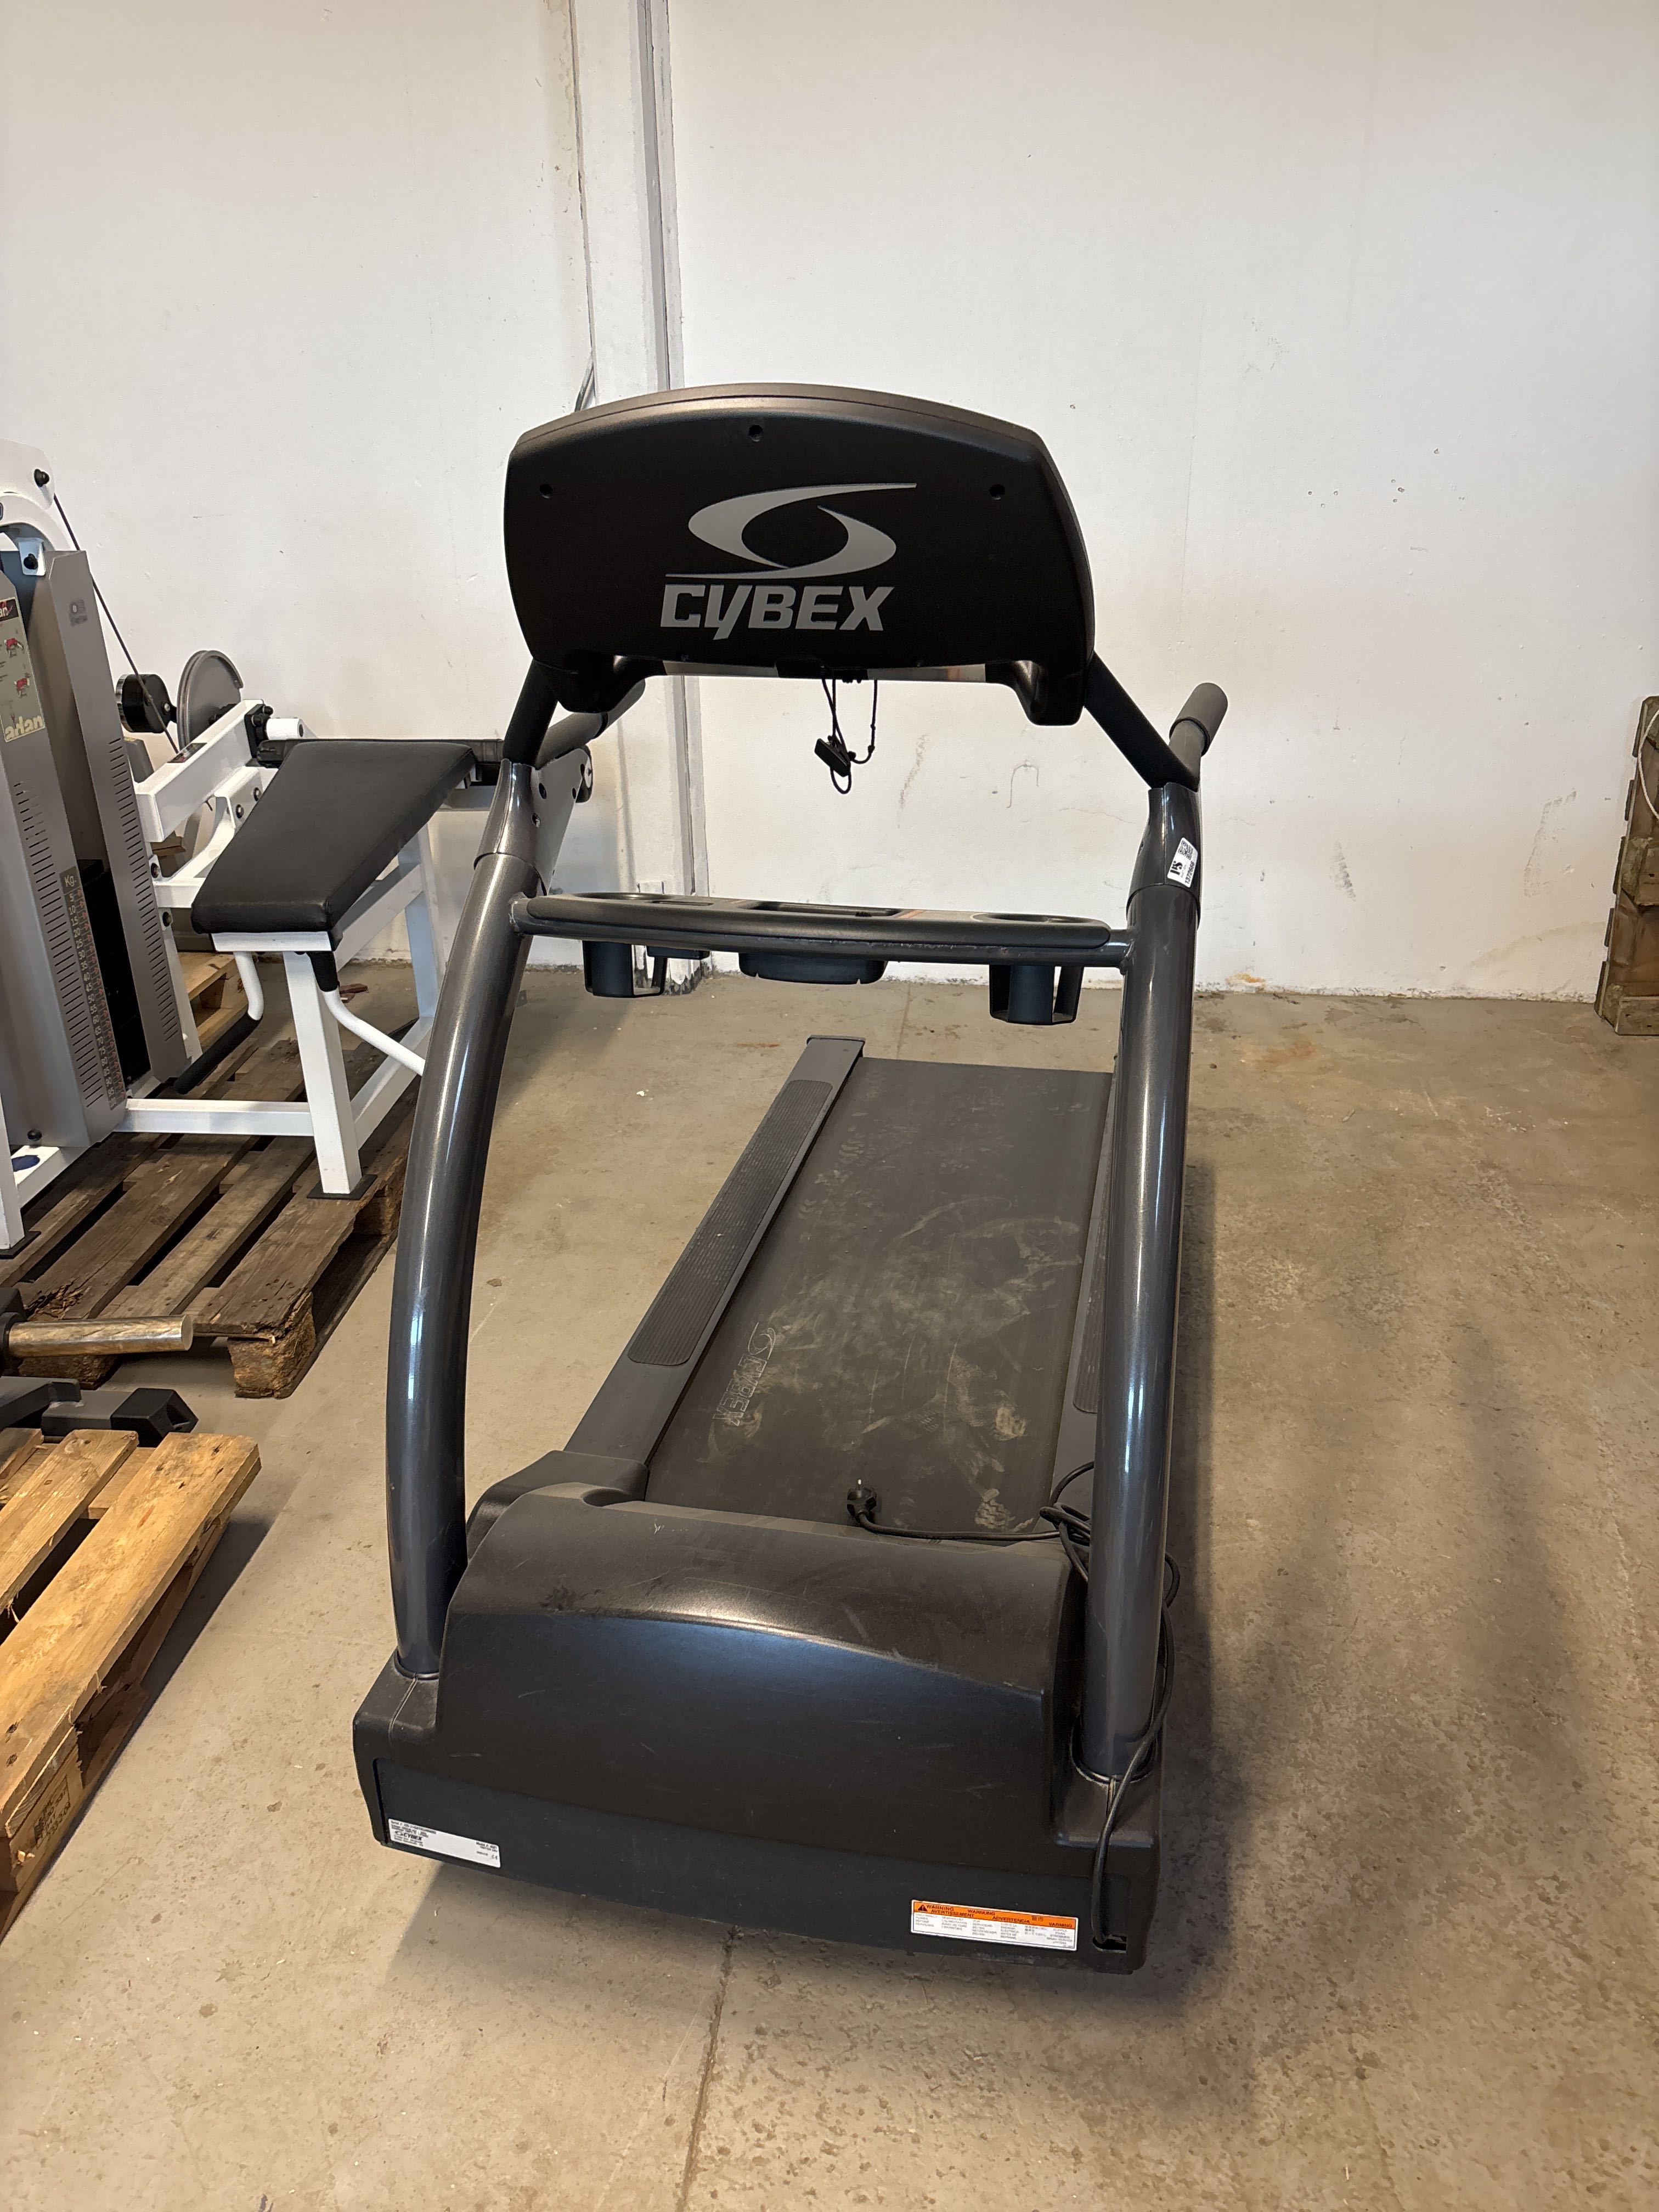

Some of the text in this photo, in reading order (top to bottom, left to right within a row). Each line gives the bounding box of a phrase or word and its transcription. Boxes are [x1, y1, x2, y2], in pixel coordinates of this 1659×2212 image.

[660, 584, 895, 640] CYBEX
[70, 894, 74, 902] 5
[69, 905, 76, 915] 10
[71, 917, 78, 926] 15
[74, 928, 81, 938] 20
[76, 939, 83, 949] 25
[78, 950, 86, 960] 30
[81, 961, 88, 970] 35
[83, 972, 90, 981] 40
[86, 982, 93, 992] 45
[90, 1004, 97, 1014] 55
[93, 1014, 99, 1024] 60
[99, 1046, 106, 1056] 75
[712, 1353, 768, 1426] CYBEX
